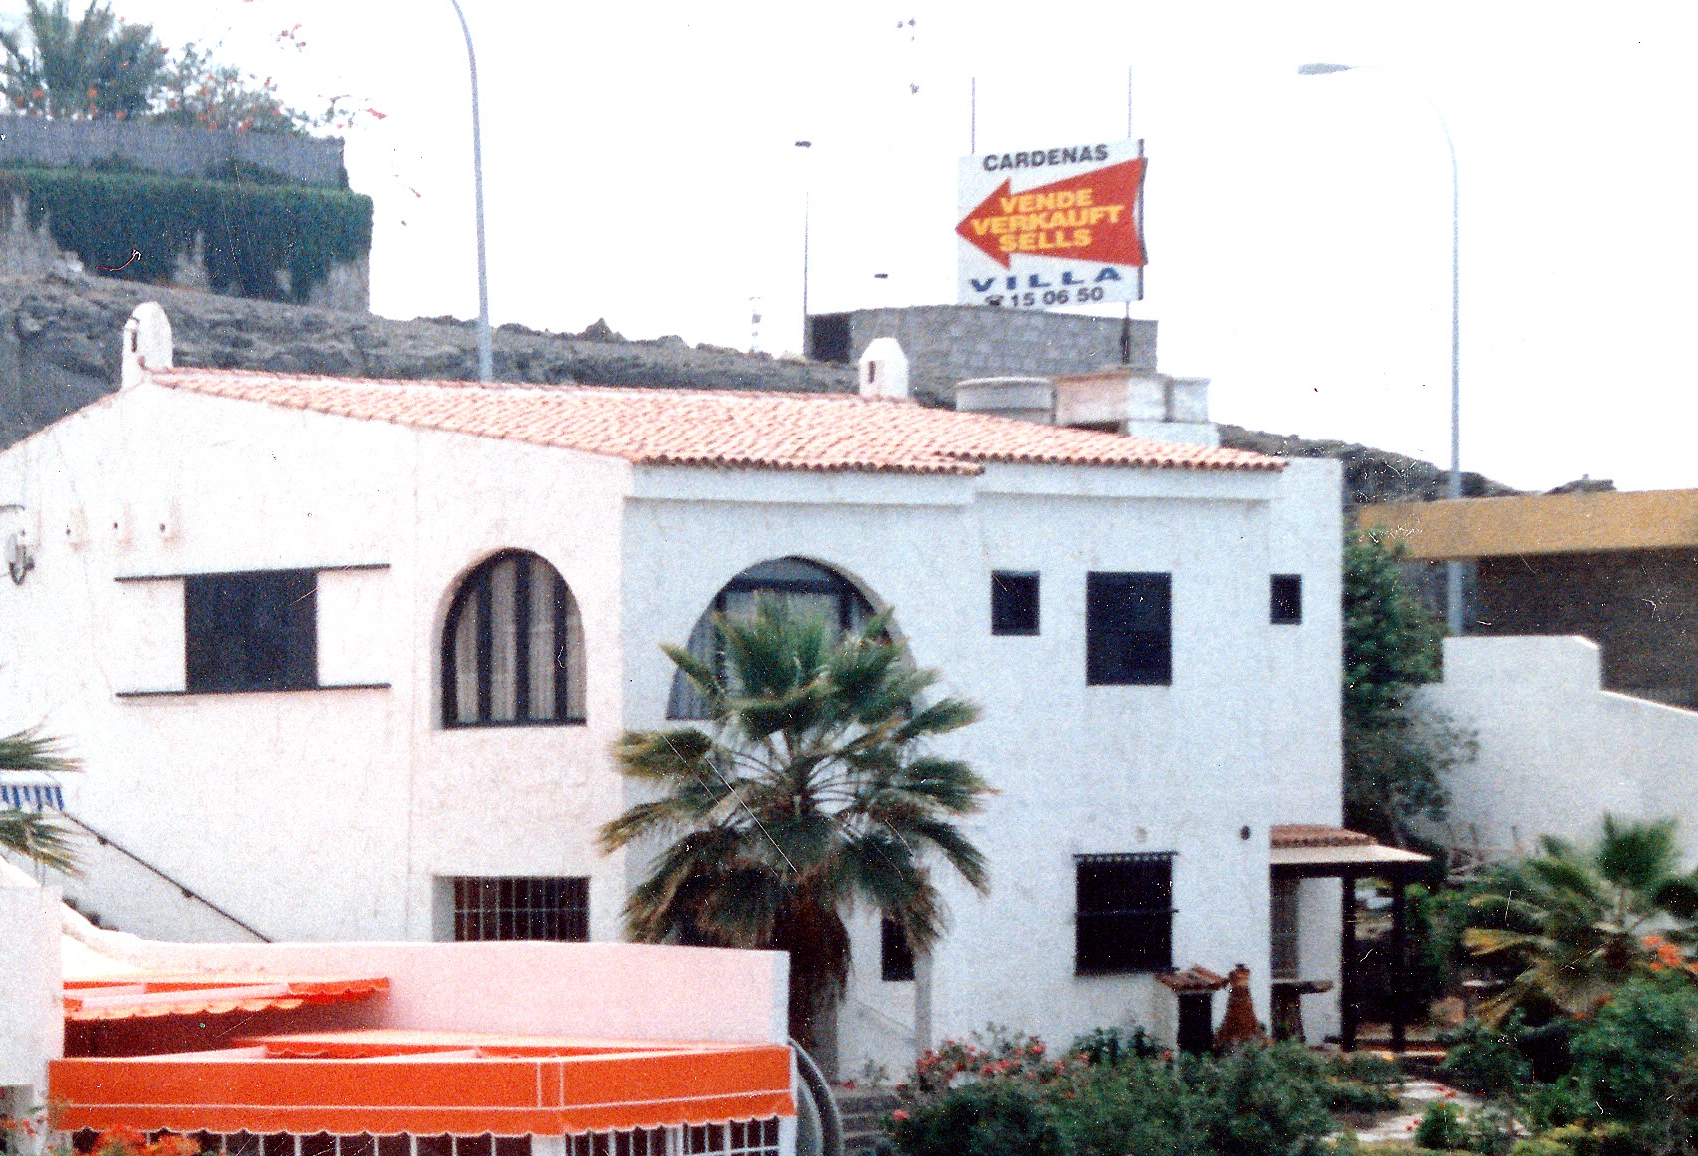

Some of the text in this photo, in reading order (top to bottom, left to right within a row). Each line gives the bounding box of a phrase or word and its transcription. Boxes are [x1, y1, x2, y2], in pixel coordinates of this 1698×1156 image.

[983, 144, 1108, 171] CARDENAS
[1001, 188, 1092, 213] VENDE
[970, 205, 1125, 235] VERKAUFT
[999, 228, 1092, 252] SELLS
[969, 267, 1121, 292] VILLA
[1042, 289, 1069, 305] 06
[1077, 287, 1104, 302] 50
